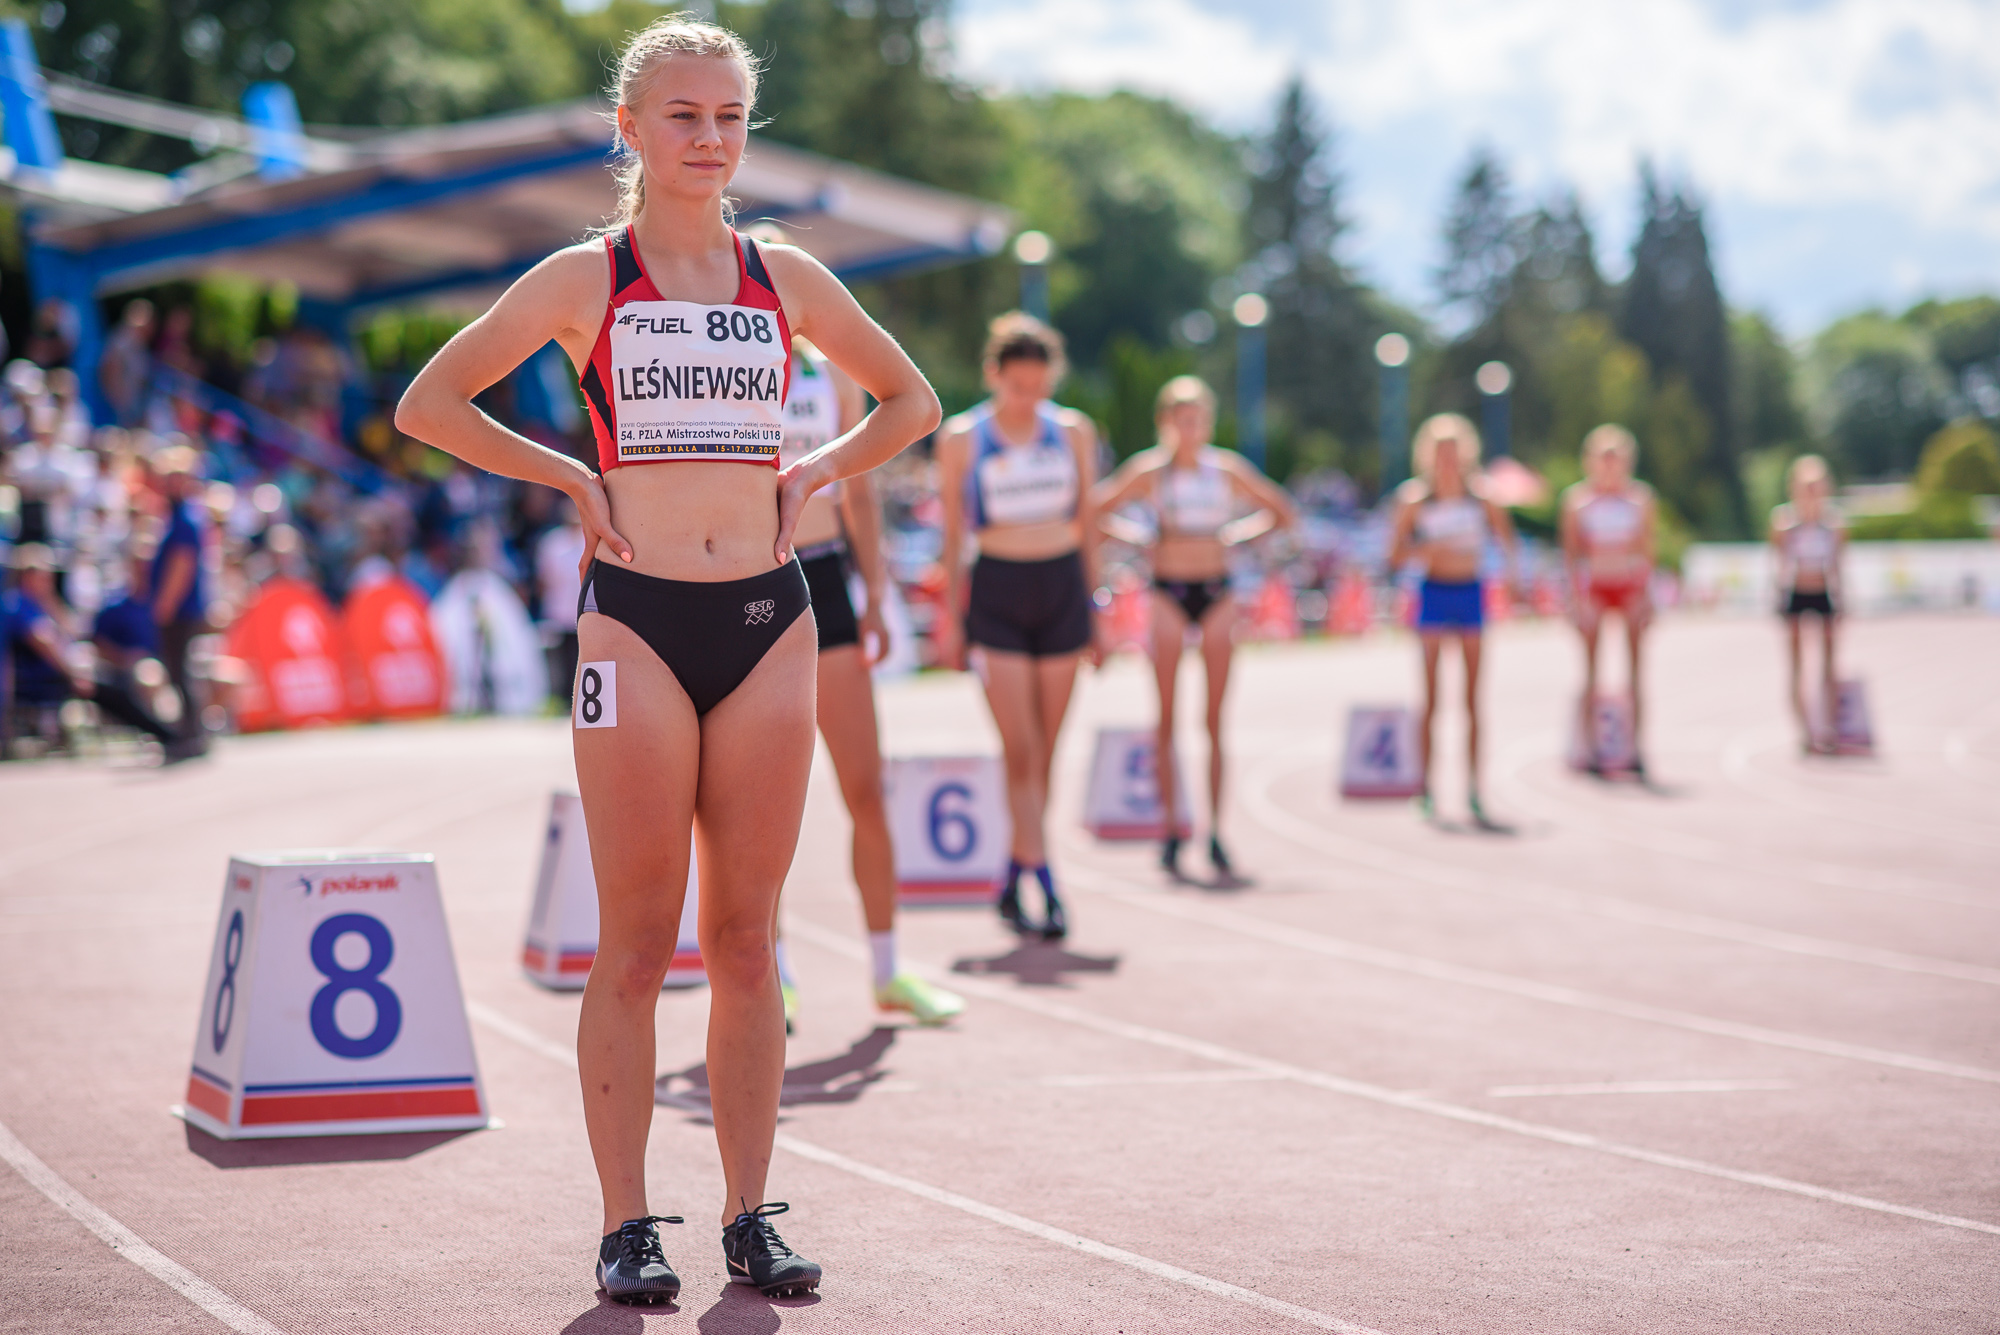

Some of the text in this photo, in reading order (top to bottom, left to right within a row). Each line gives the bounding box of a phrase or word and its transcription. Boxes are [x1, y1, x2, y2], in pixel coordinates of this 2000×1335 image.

[636, 318, 693, 335] FUEL
[706, 310, 773, 344] 808
[618, 358, 778, 401] LEŚNIEWSKA
[620, 428, 781, 441] 54. PZLA Mistrzostwa Polski U18
[636, 421, 675, 429] Ogólnopolska
[676, 420, 707, 428] Olimpiada
[623, 445, 698, 455] BIELSKO-BIAŁA
[715, 444, 778, 454] 15-17.07.2022
[581, 667, 603, 724] 8
[927, 781, 978, 863] 6
[213, 908, 245, 1058] 8
[308, 912, 404, 1062] 8
